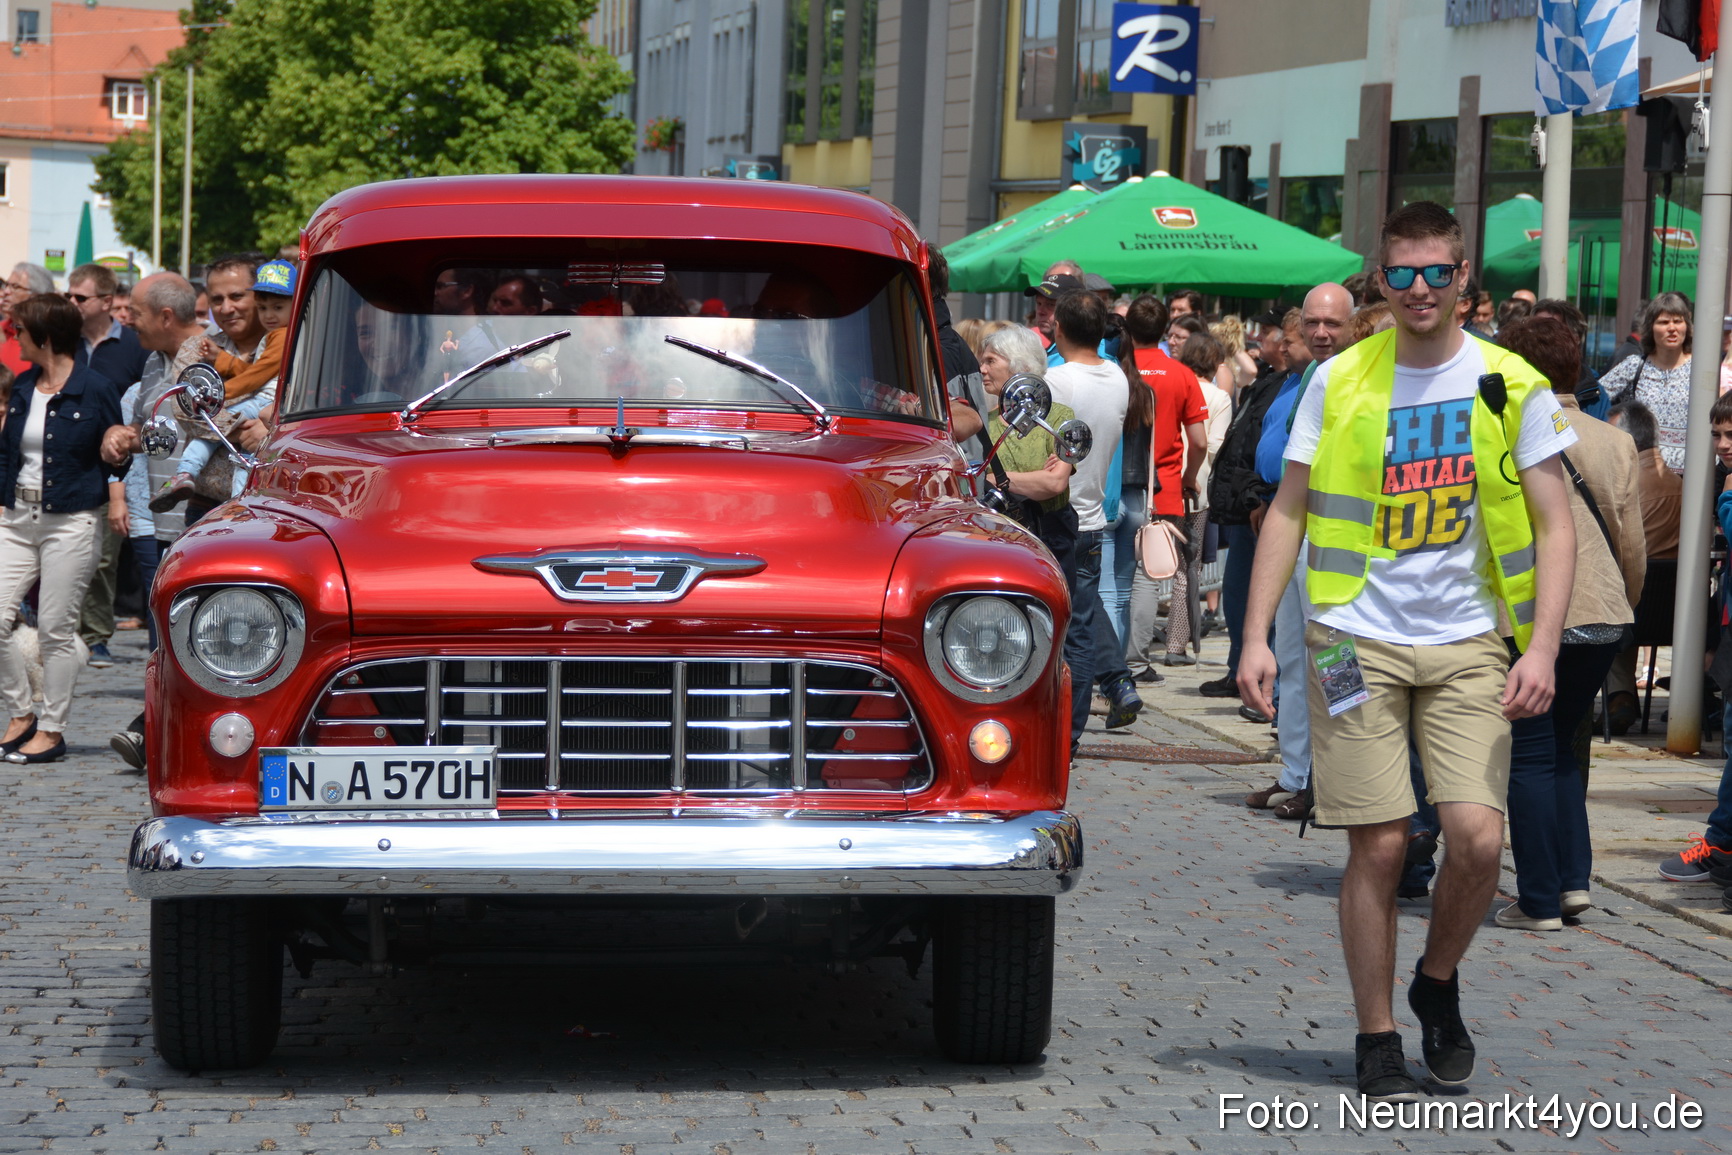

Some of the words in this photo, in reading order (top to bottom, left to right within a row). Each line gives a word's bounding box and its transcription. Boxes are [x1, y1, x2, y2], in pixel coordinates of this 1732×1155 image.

[1094, 147, 1121, 182] G2
[1118, 240, 1259, 251] Lammsbräu
[1134, 232, 1236, 241] Neumarkter
[1387, 400, 1475, 464] HE
[1383, 455, 1476, 493] ANIAC
[1373, 484, 1472, 551] OE
[270, 786, 280, 799] D
[289, 761, 315, 801] N
[347, 761, 372, 800] A
[383, 760, 491, 800] 570H
